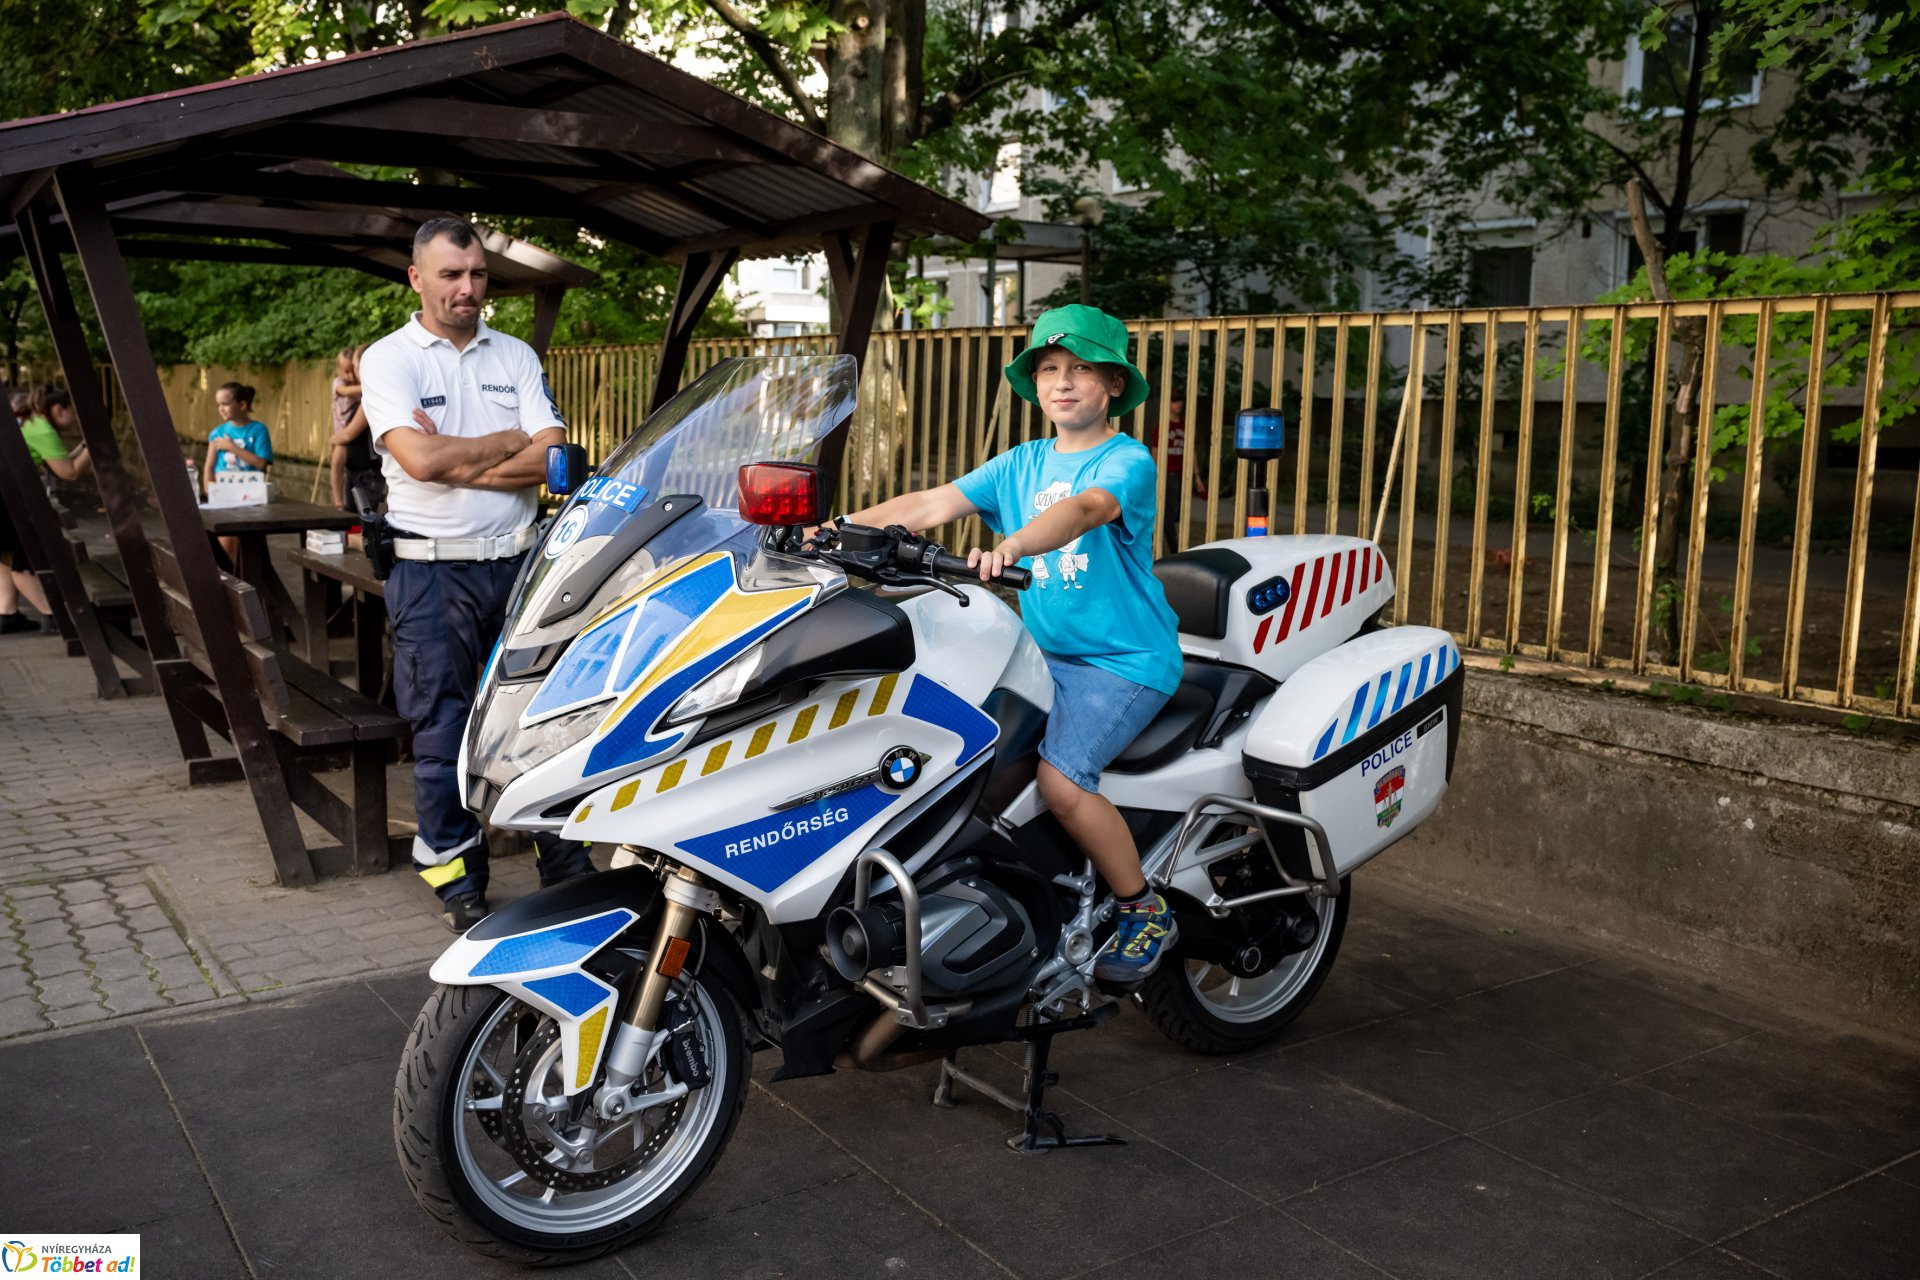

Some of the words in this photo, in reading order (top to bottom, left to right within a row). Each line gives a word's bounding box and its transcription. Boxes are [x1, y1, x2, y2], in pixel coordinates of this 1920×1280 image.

[555, 520, 578, 544] 16
[1423, 715, 1439, 732] BMW
[884, 750, 917, 768] BMW
[1361, 730, 1413, 777] POLICE
[724, 807, 849, 859] RENDŐRSÉG
[682, 1038, 699, 1077] brembo
